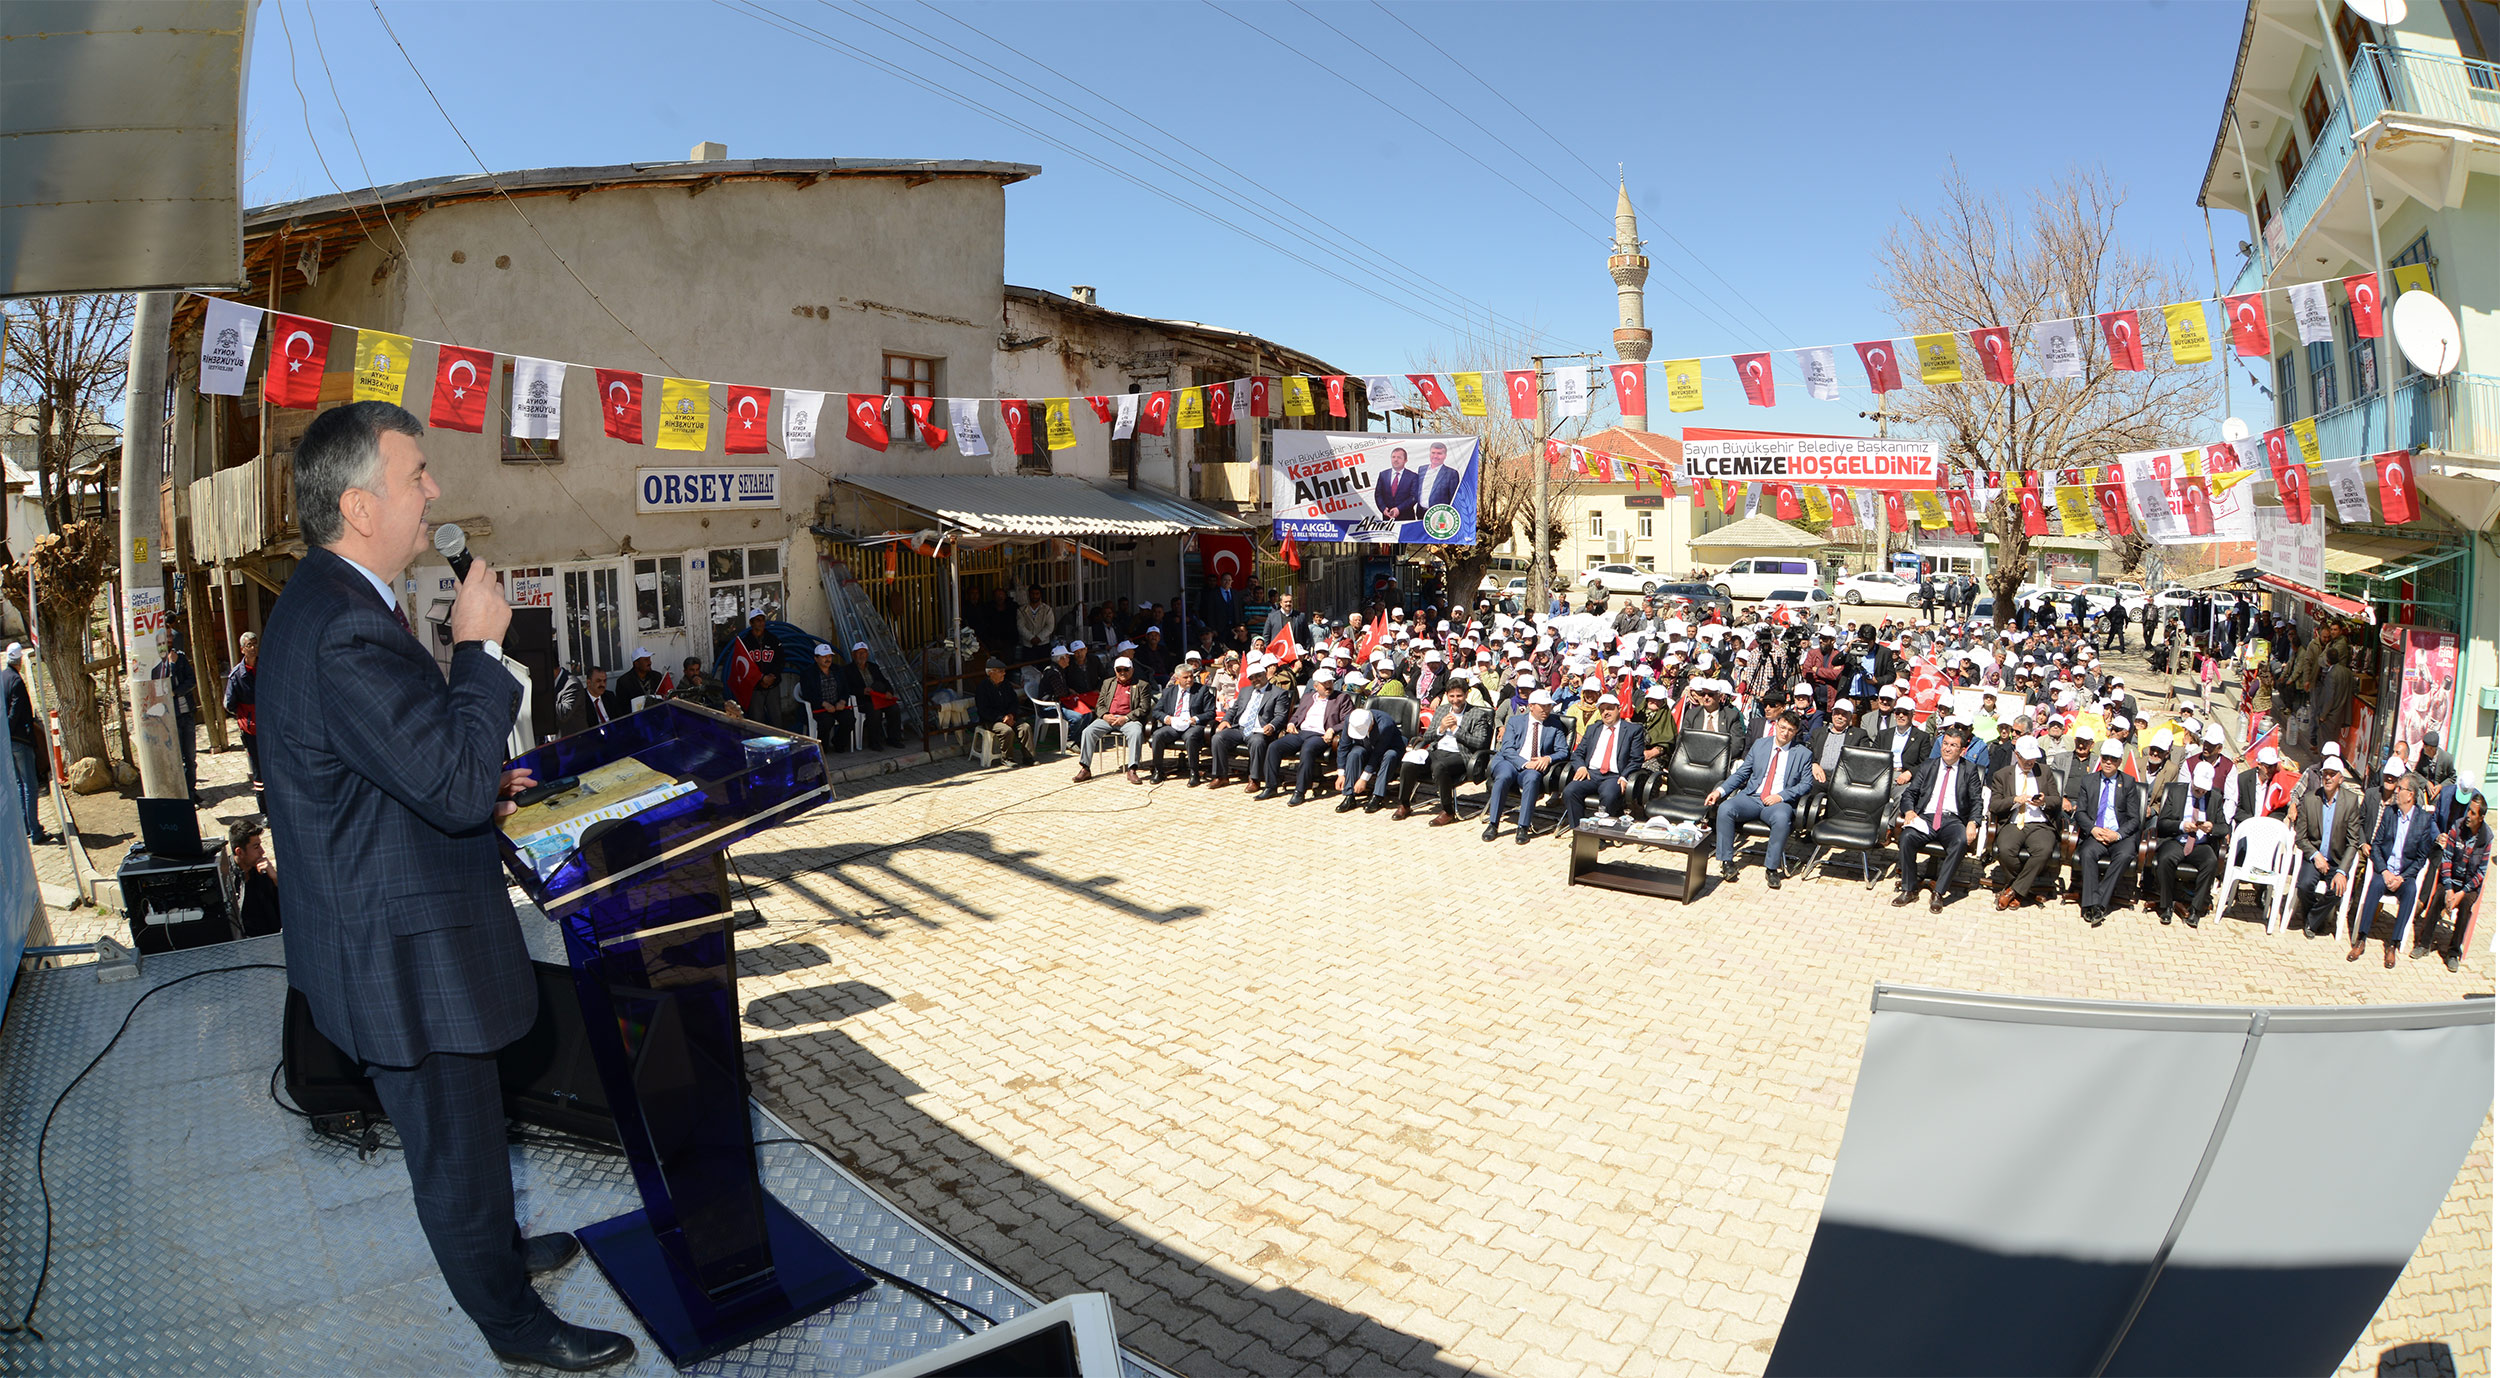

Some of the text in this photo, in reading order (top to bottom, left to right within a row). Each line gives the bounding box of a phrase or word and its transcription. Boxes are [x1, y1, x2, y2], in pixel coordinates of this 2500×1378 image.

[1278, 457, 1297, 467] Yeni
[1298, 446, 1346, 464] Büyükşehir
[1347, 439, 1376, 450] Yasası
[1684, 441, 1929, 458] Sayın Büyükşehir Belediye Başkanımız
[1287, 452, 1366, 481] Kazanan
[643, 473, 775, 505] ORSEY SEYAHAT
[1295, 466, 1372, 505] Ahırlı
[1301, 521, 1339, 533] AKGÜL
[441, 580, 453, 589] 6A
[131, 591, 149, 602] ÖNCE
[750, 649, 775, 662] 1967
[159, 823, 179, 832] VAIO
